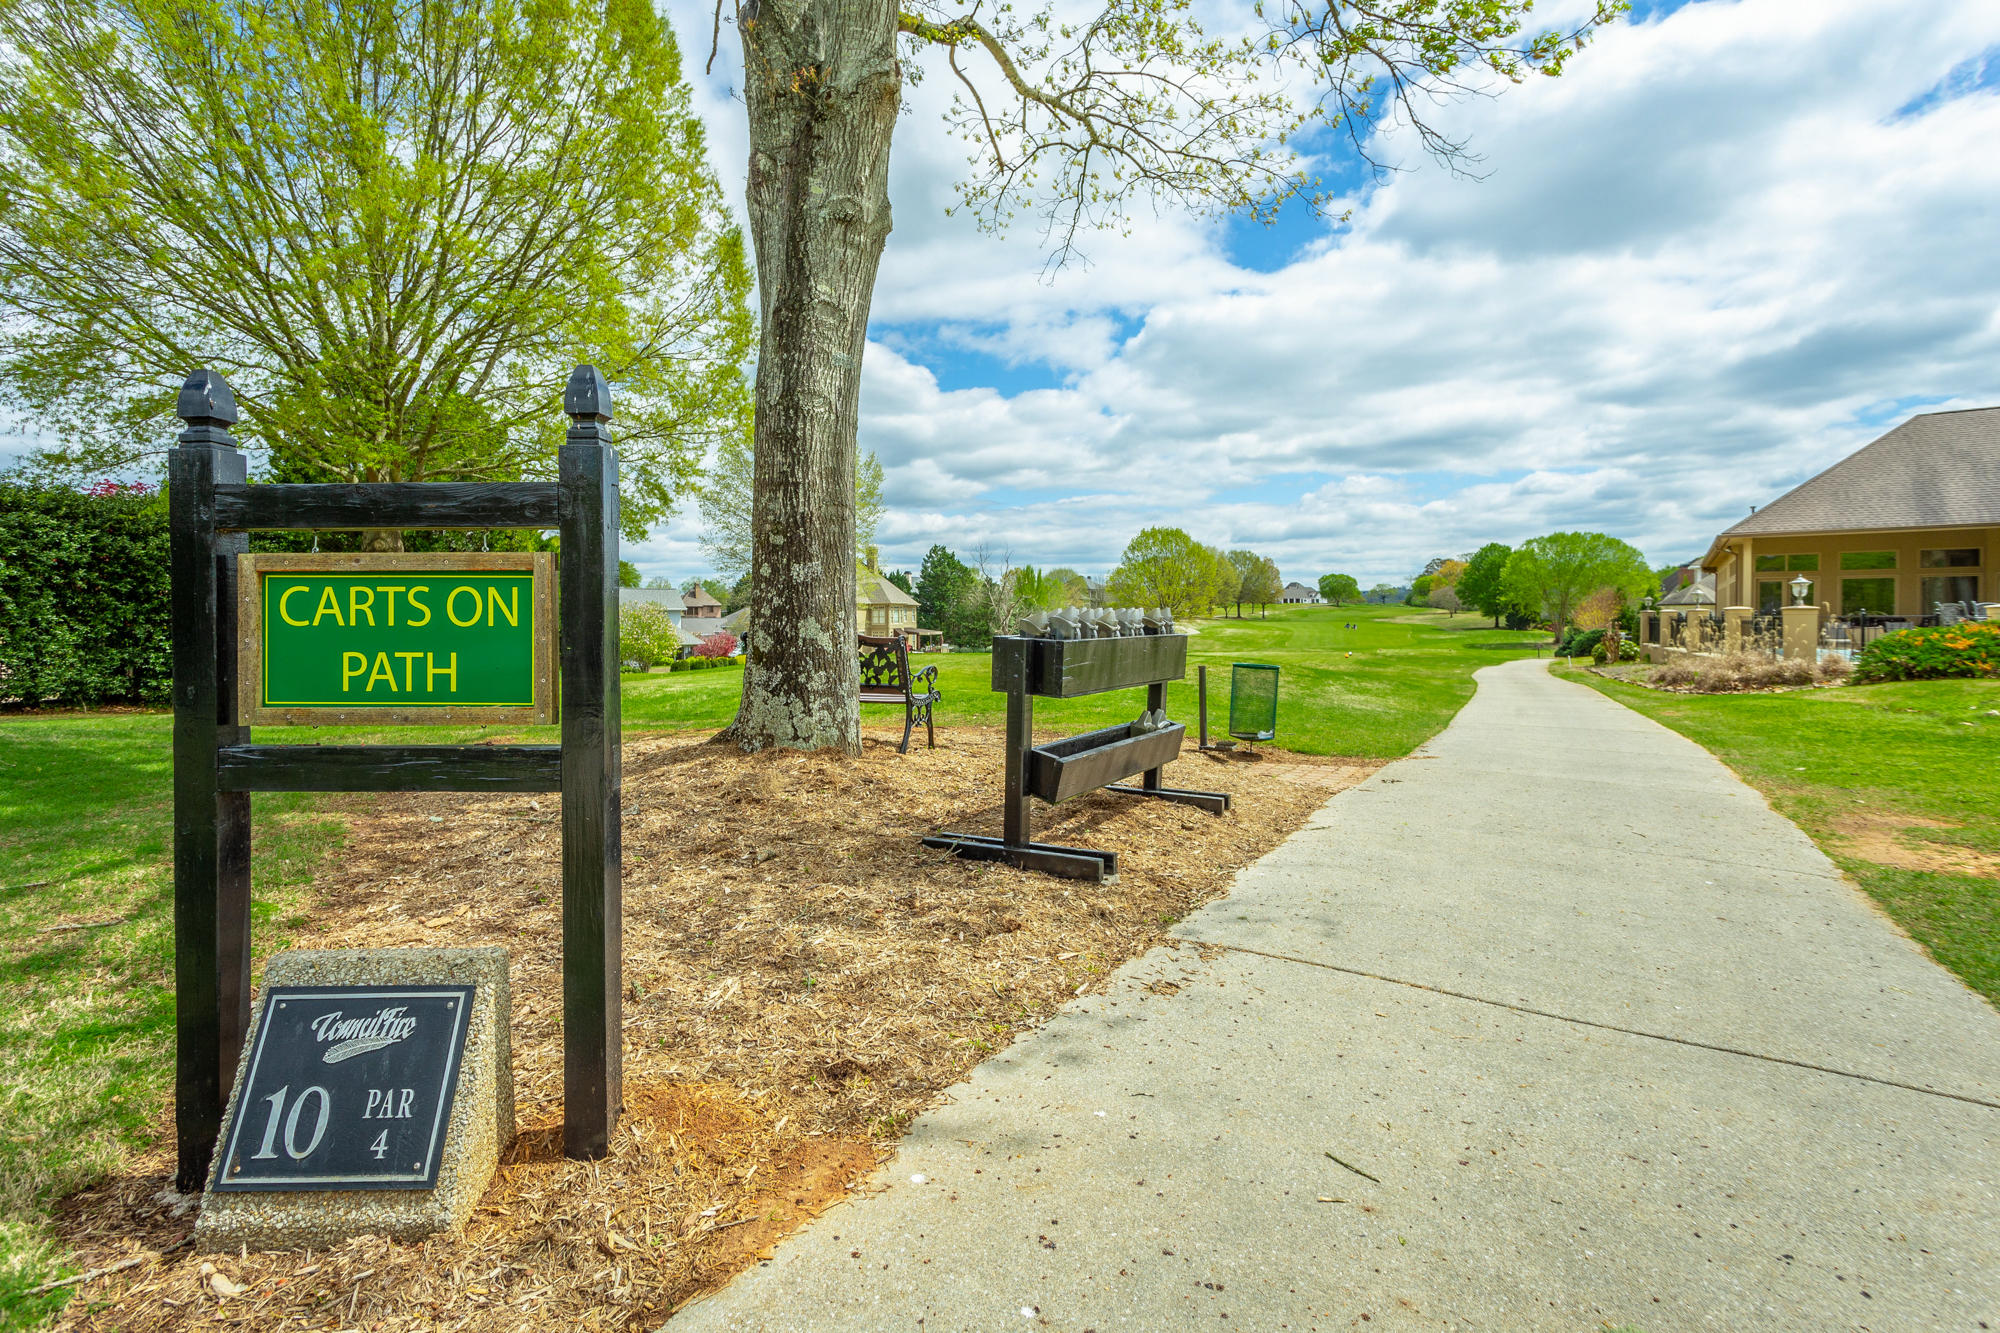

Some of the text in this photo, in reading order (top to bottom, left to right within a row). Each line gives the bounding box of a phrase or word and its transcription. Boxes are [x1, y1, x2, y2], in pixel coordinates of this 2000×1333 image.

[279, 585, 519, 628] CARTS ON
[342, 651, 457, 692] PATH
[250, 1084, 331, 1160] 10
[362, 1088, 415, 1119] PAR
[369, 1128, 389, 1159] 4
